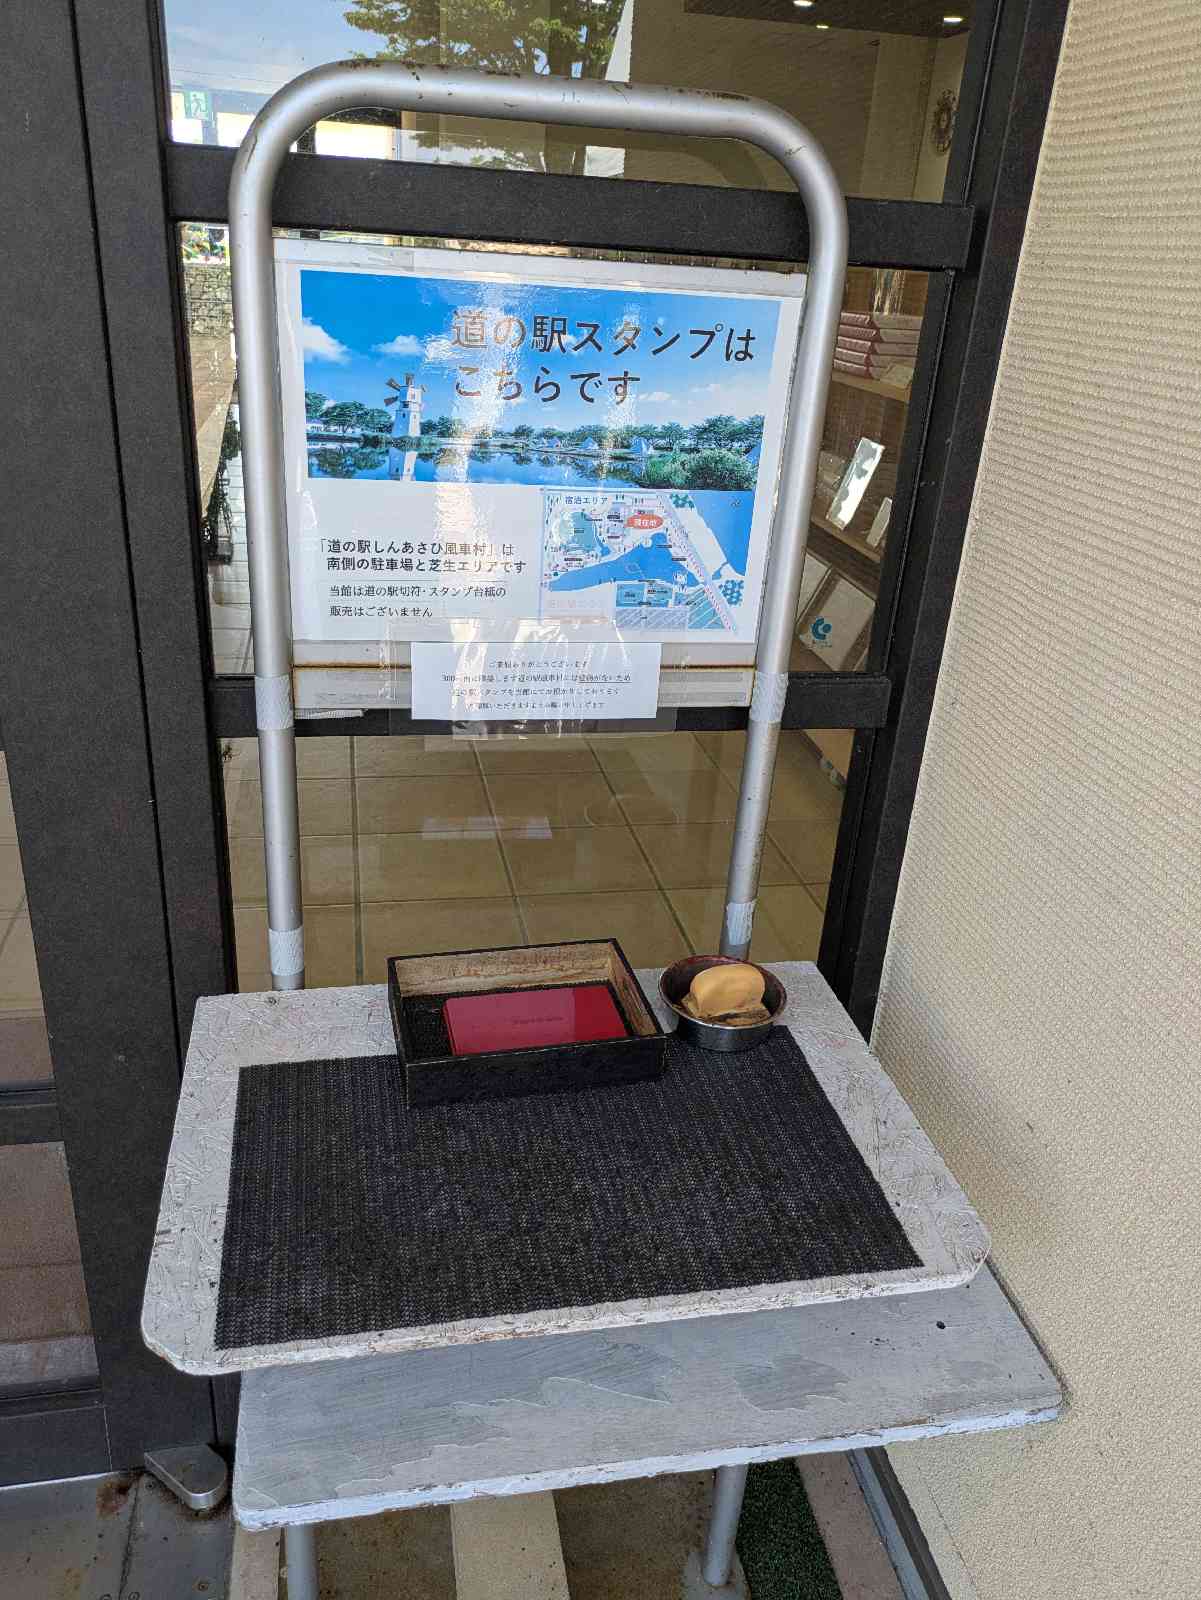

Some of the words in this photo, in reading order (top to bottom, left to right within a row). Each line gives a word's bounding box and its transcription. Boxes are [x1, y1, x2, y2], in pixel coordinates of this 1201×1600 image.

[451, 310, 757, 362] 道の駅スタンプは
[455, 366, 641, 405] こちらです
[320, 538, 515, 557] 「道の駅しんあさひ風車村」は
[327, 557, 526, 574] 南側の駐車場と芝生エリアです
[330, 606, 433, 617] 販売はございません
